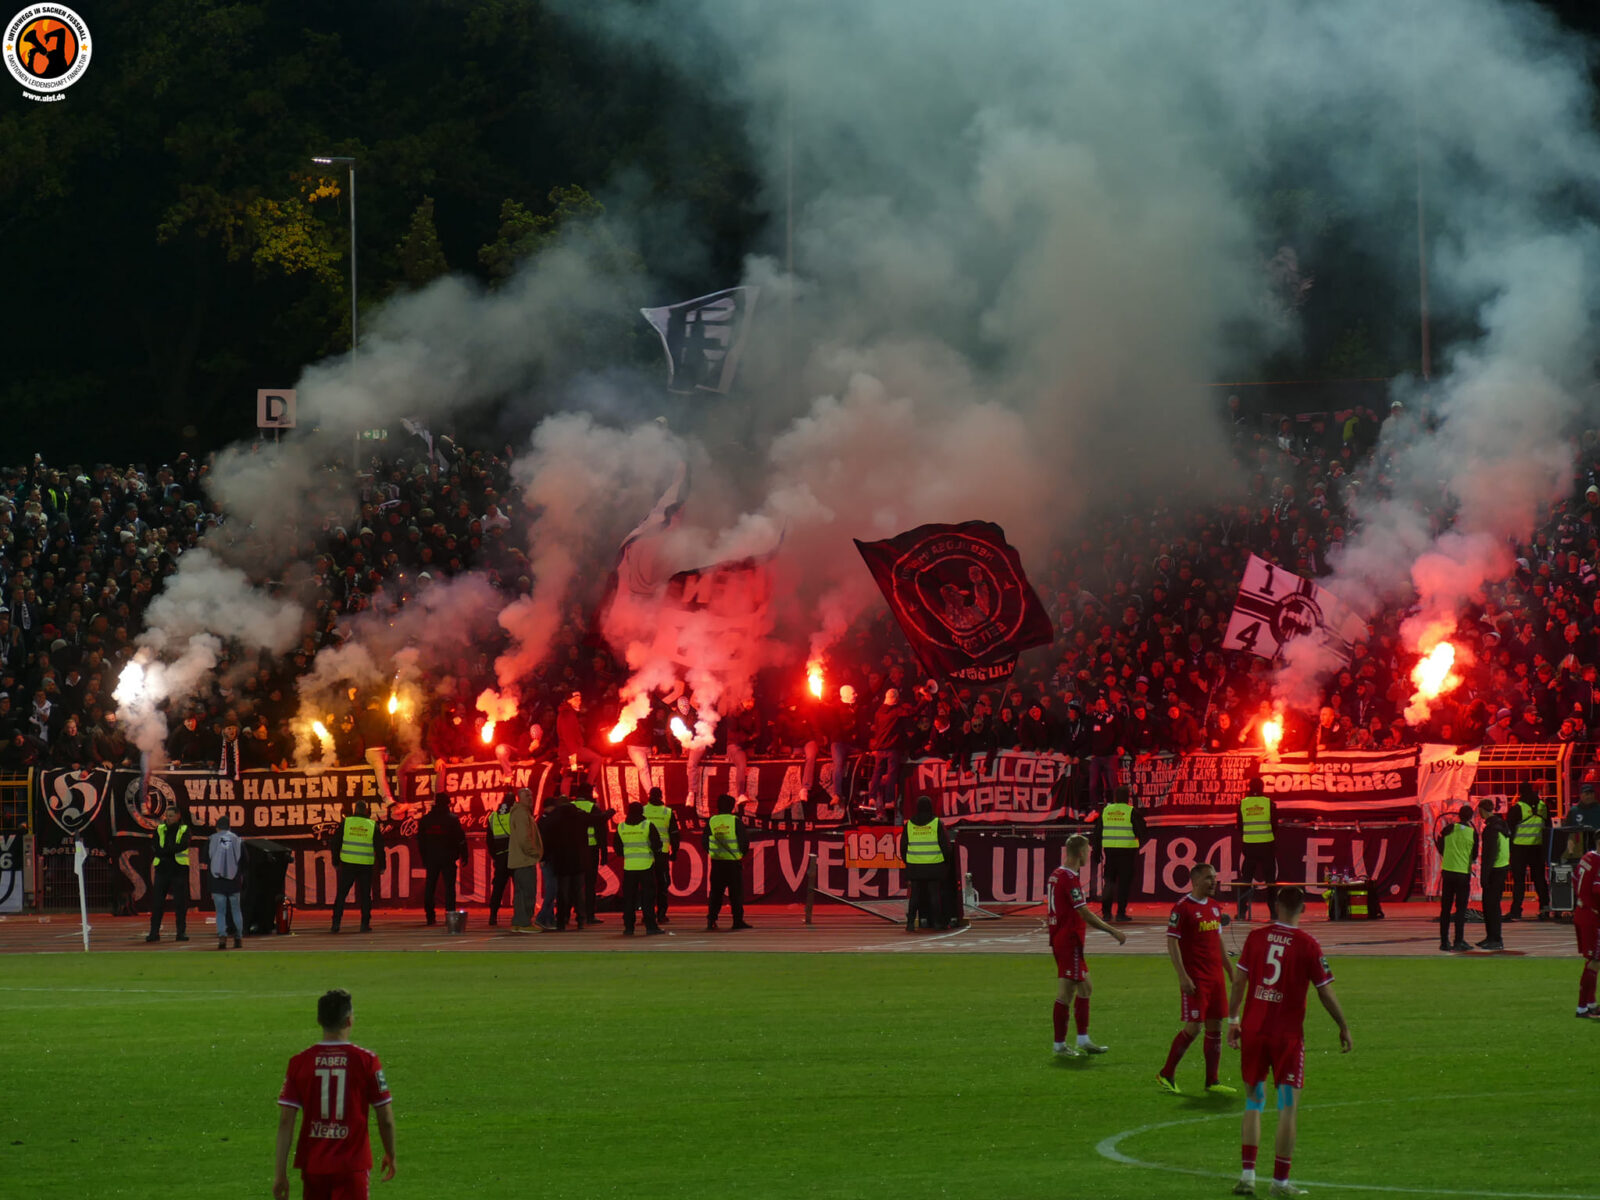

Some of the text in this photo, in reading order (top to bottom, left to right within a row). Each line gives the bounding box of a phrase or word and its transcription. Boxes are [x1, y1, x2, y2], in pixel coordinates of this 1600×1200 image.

[266, 396, 287, 421] D
[1259, 564, 1274, 596] 1
[1235, 622, 1261, 651] 4
[1429, 759, 1465, 774] 1999
[184, 768, 532, 801] WIR HALTEN FET ZSAMMN
[1261, 771, 1402, 793] constante
[189, 805, 245, 827] UND
[254, 803, 343, 827] GEHEN
[943, 785, 1052, 816] IMPERO
[1139, 834, 1279, 898] 184
[1267, 933, 1293, 945] BULIC
[1263, 944, 1285, 985] 5
[315, 1056, 347, 1066] FABER
[315, 1069, 346, 1119] 11
